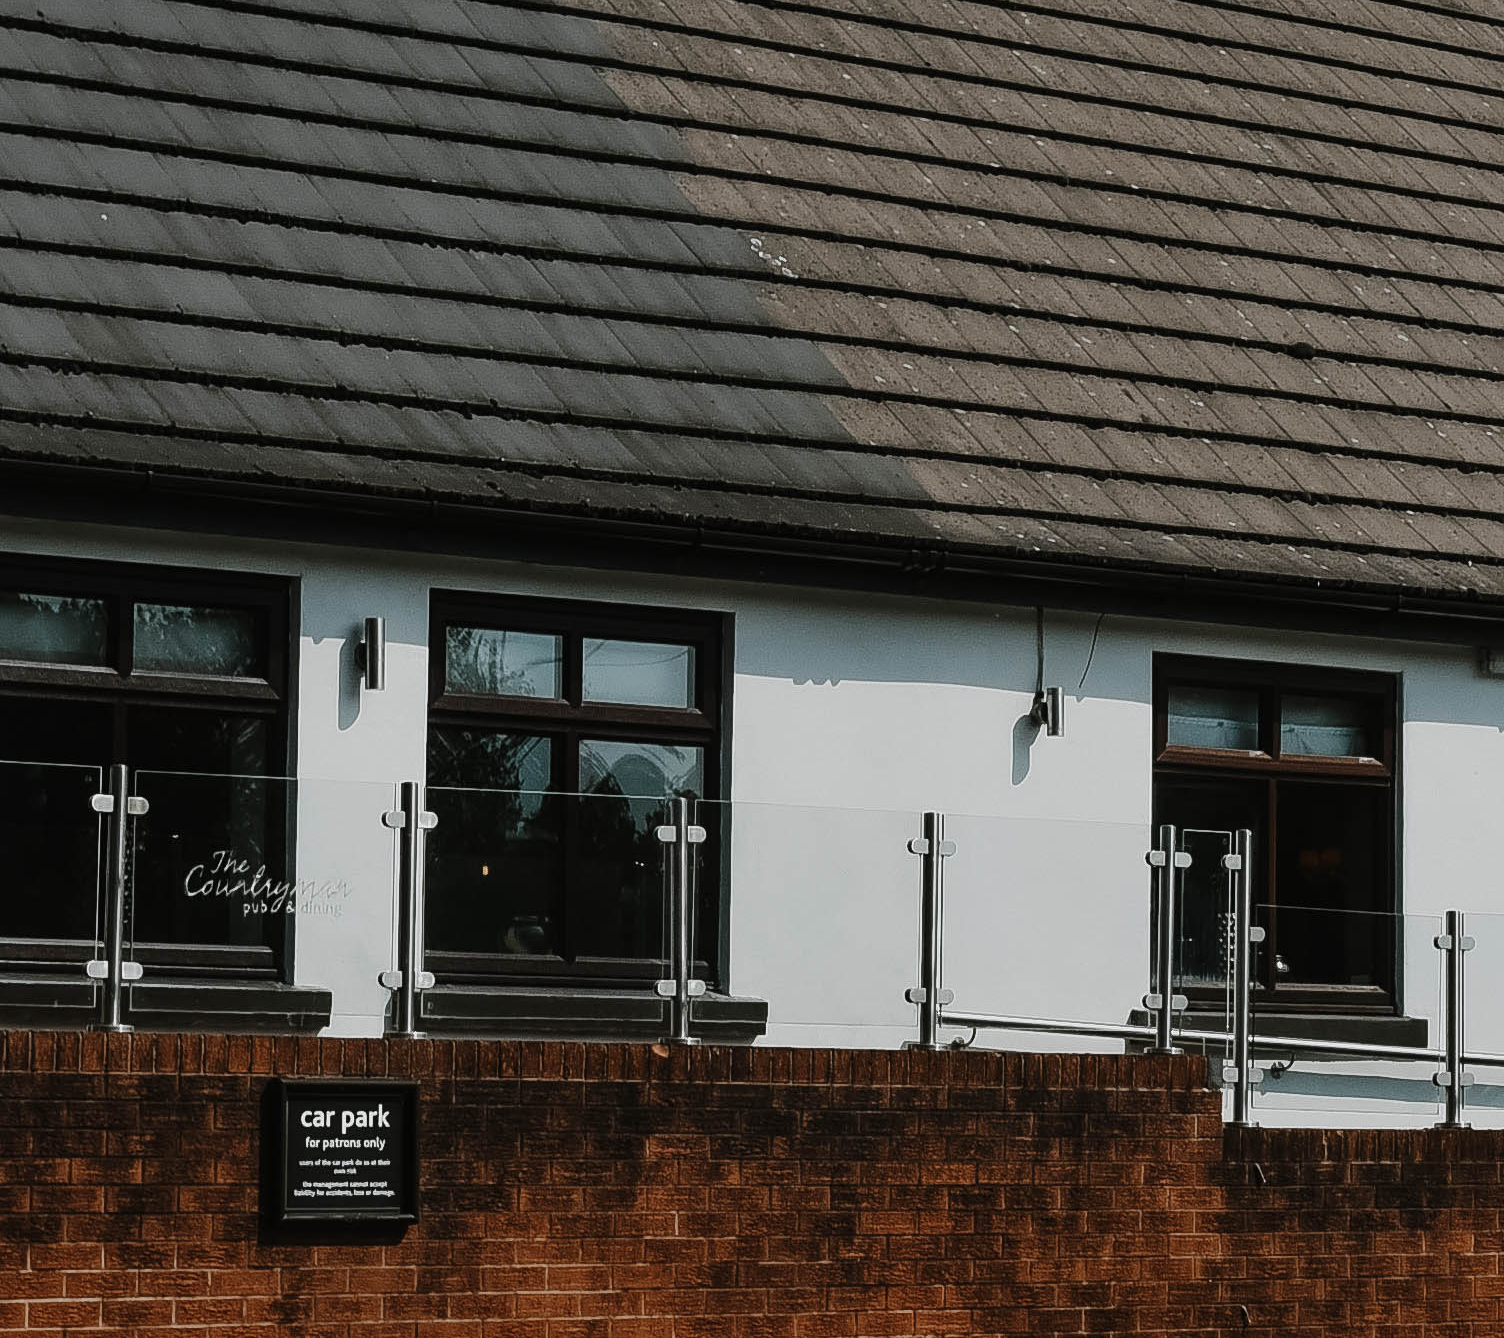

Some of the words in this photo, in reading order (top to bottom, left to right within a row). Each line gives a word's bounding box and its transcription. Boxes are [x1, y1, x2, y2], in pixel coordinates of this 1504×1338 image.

[210, 849, 251, 874] The
[243, 899, 268, 917] pub
[300, 1110, 336, 1128] car
[341, 1103, 391, 1135] park
[305, 1136, 320, 1148] for
[322, 1137, 362, 1152] patrons
[363, 1136, 386, 1151] only
